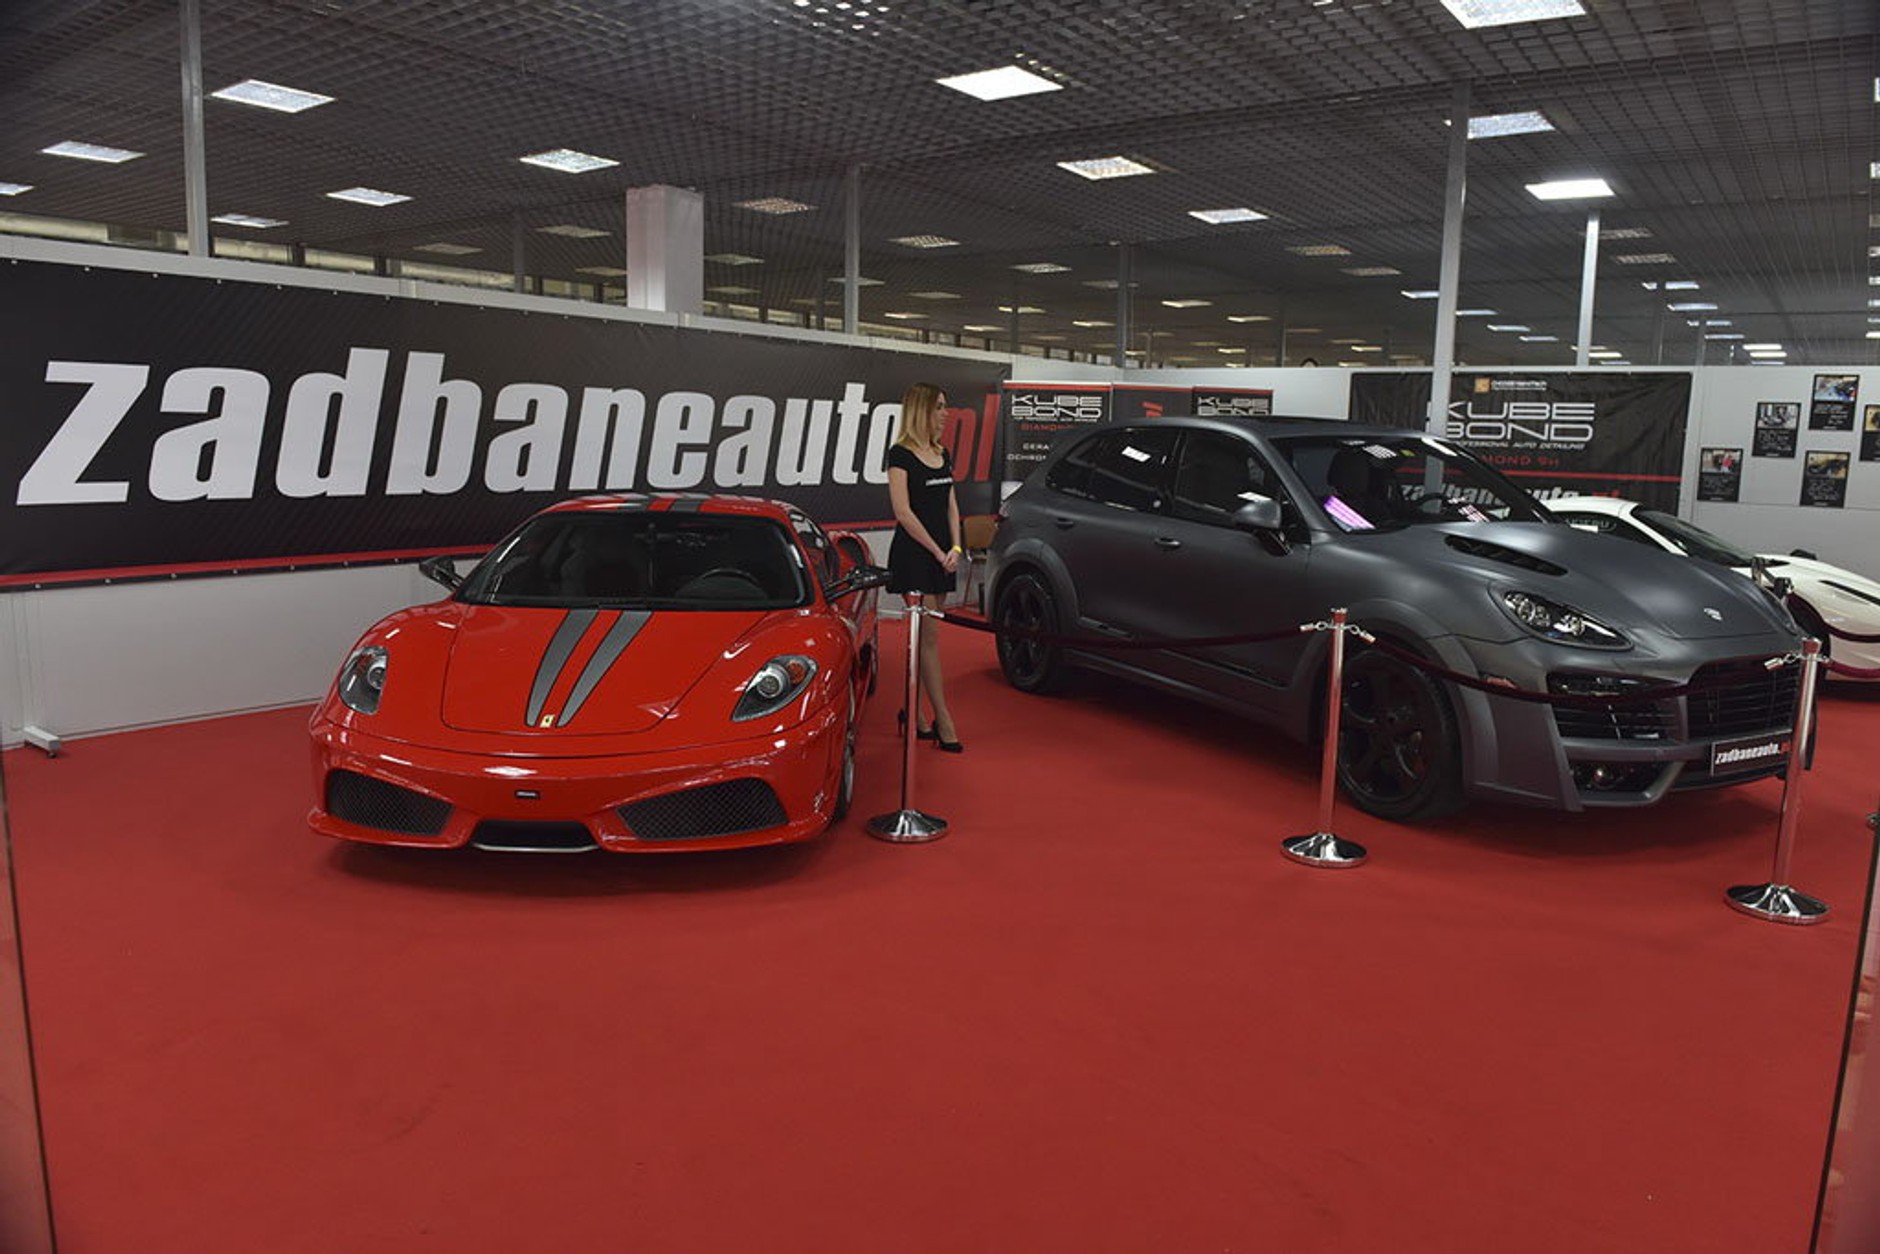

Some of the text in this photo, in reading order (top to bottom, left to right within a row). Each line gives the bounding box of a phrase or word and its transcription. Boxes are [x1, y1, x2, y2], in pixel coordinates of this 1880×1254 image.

[1011, 394, 1103, 407] KUBE
[1197, 396, 1269, 409] KUBE
[1011, 406, 1102, 418] BOND
[16, 347, 1001, 505] zadbaneautopl
